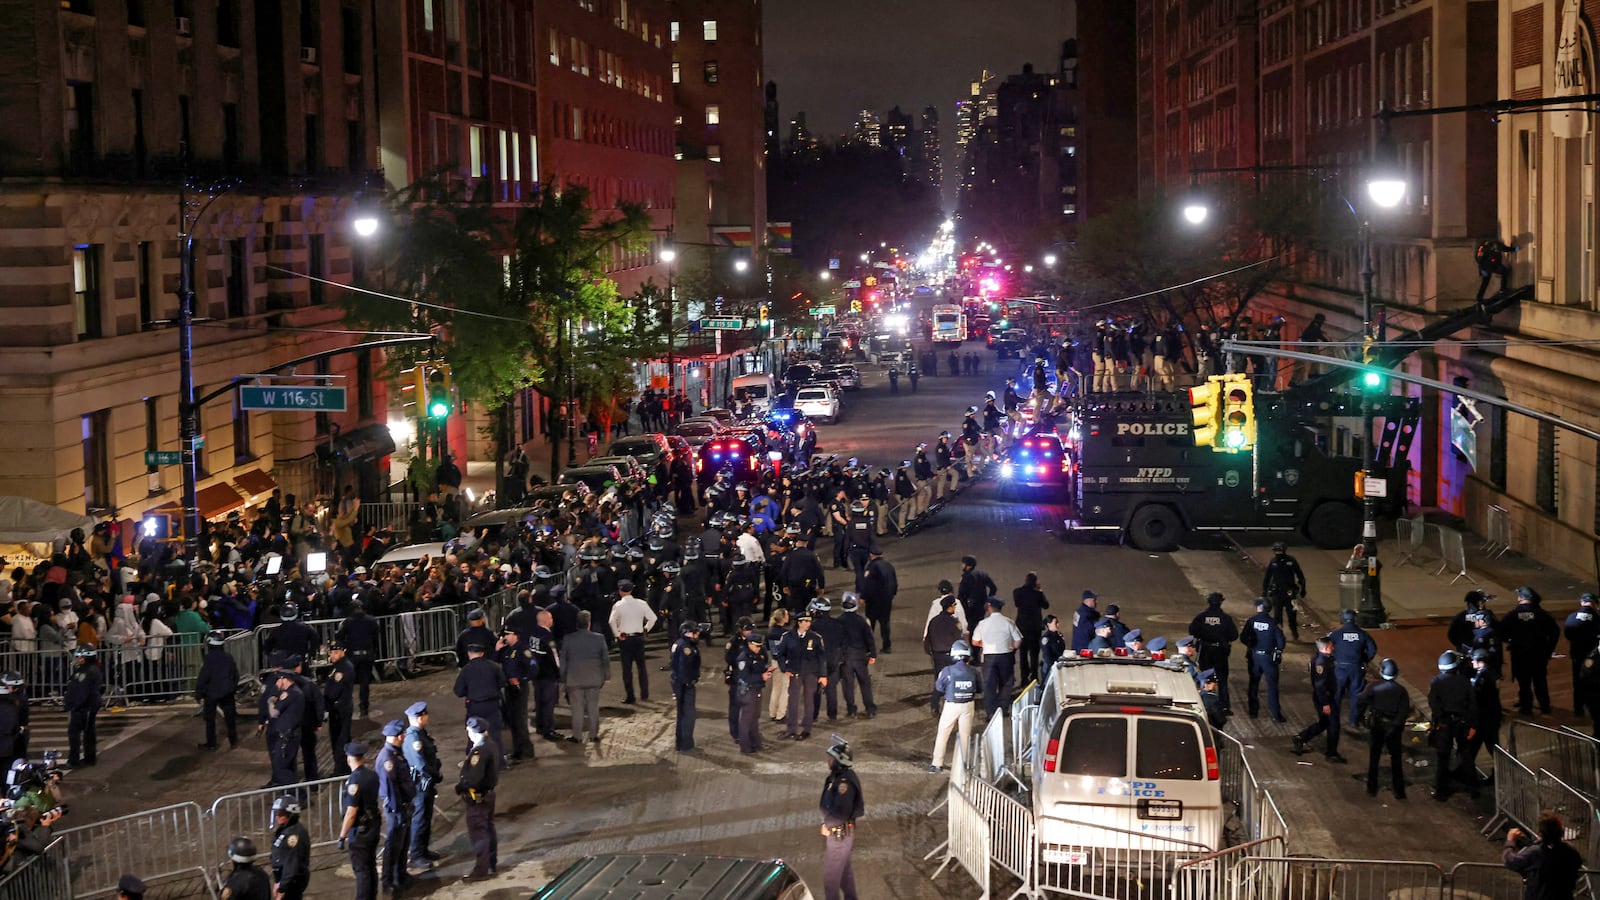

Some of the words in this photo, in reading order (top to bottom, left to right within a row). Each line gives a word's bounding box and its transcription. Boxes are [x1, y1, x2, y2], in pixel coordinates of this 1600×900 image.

[263, 391, 276, 405] W
[281, 391, 305, 405] 116
[310, 392, 324, 406] St
[1117, 423, 1188, 435] POLICE
[148, 453, 155, 463] W
[1137, 467, 1172, 477] NYPD
[1205, 616, 1221, 625] NYPD
[1253, 621, 1269, 630] NYPD
[1342, 632, 1360, 641] NYPD
[955, 681, 973, 689] NYPD
